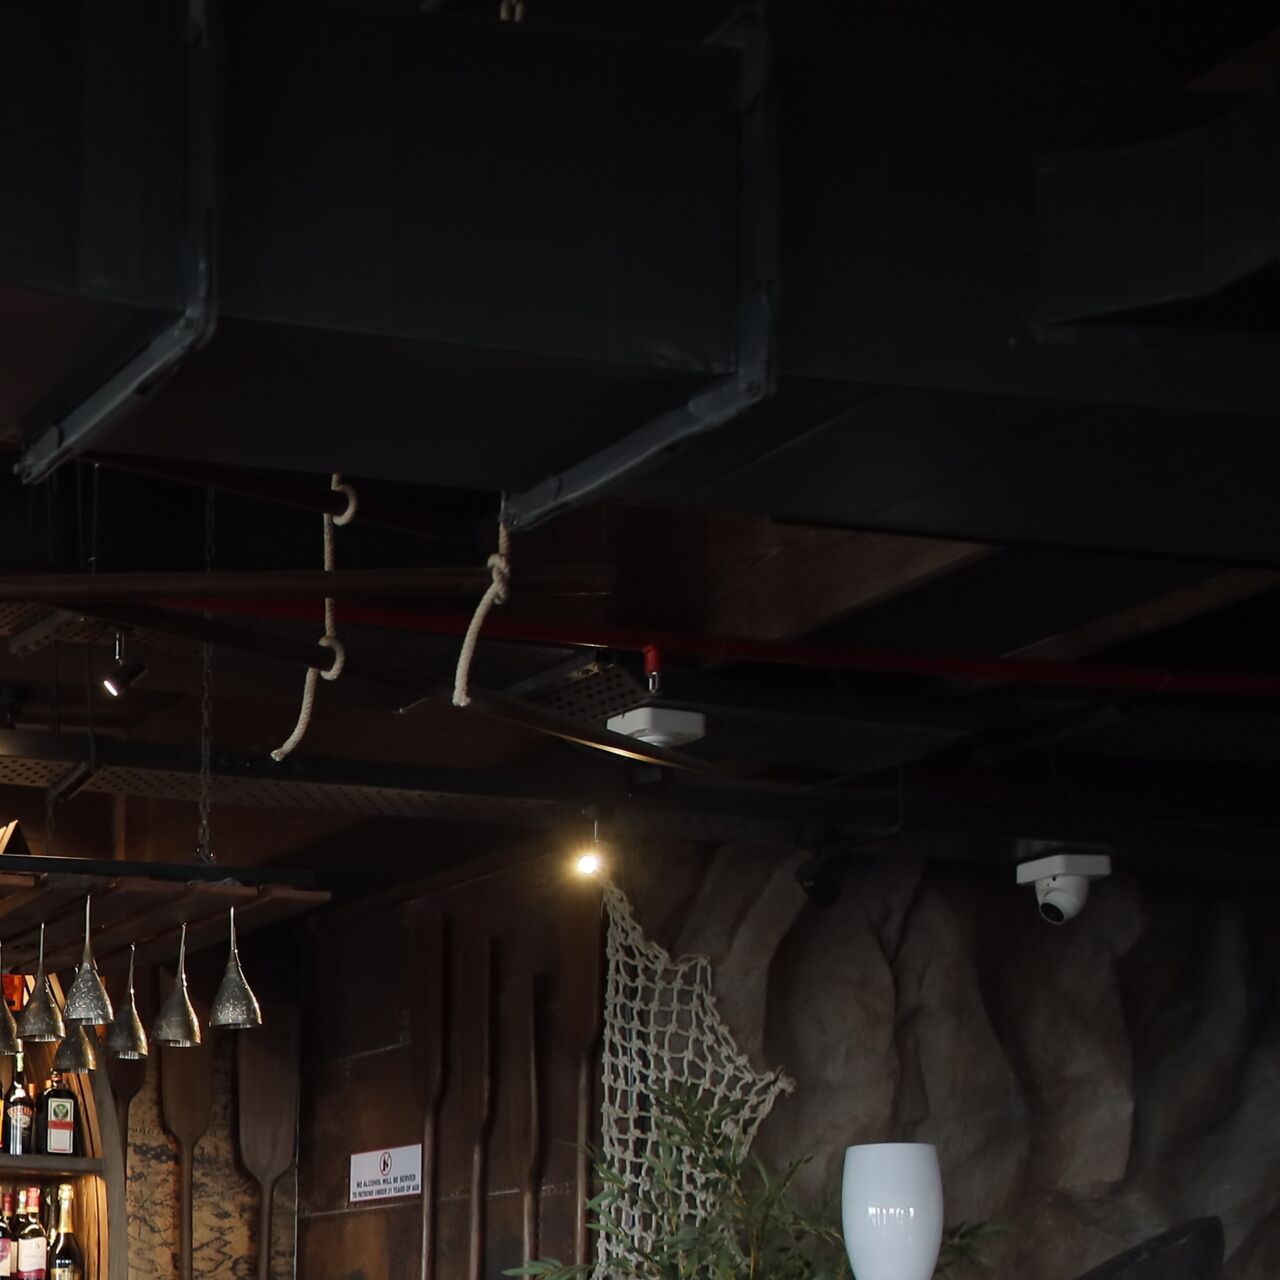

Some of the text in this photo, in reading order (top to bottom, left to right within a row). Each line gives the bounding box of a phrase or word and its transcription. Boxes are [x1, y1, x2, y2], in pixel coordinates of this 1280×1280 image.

[363, 1179, 381, 1187] ALCOHOL
[399, 1174, 416, 1182] SERVED
[375, 1188, 386, 1196] UNDER
[393, 1186, 405, 1194] YEARS
